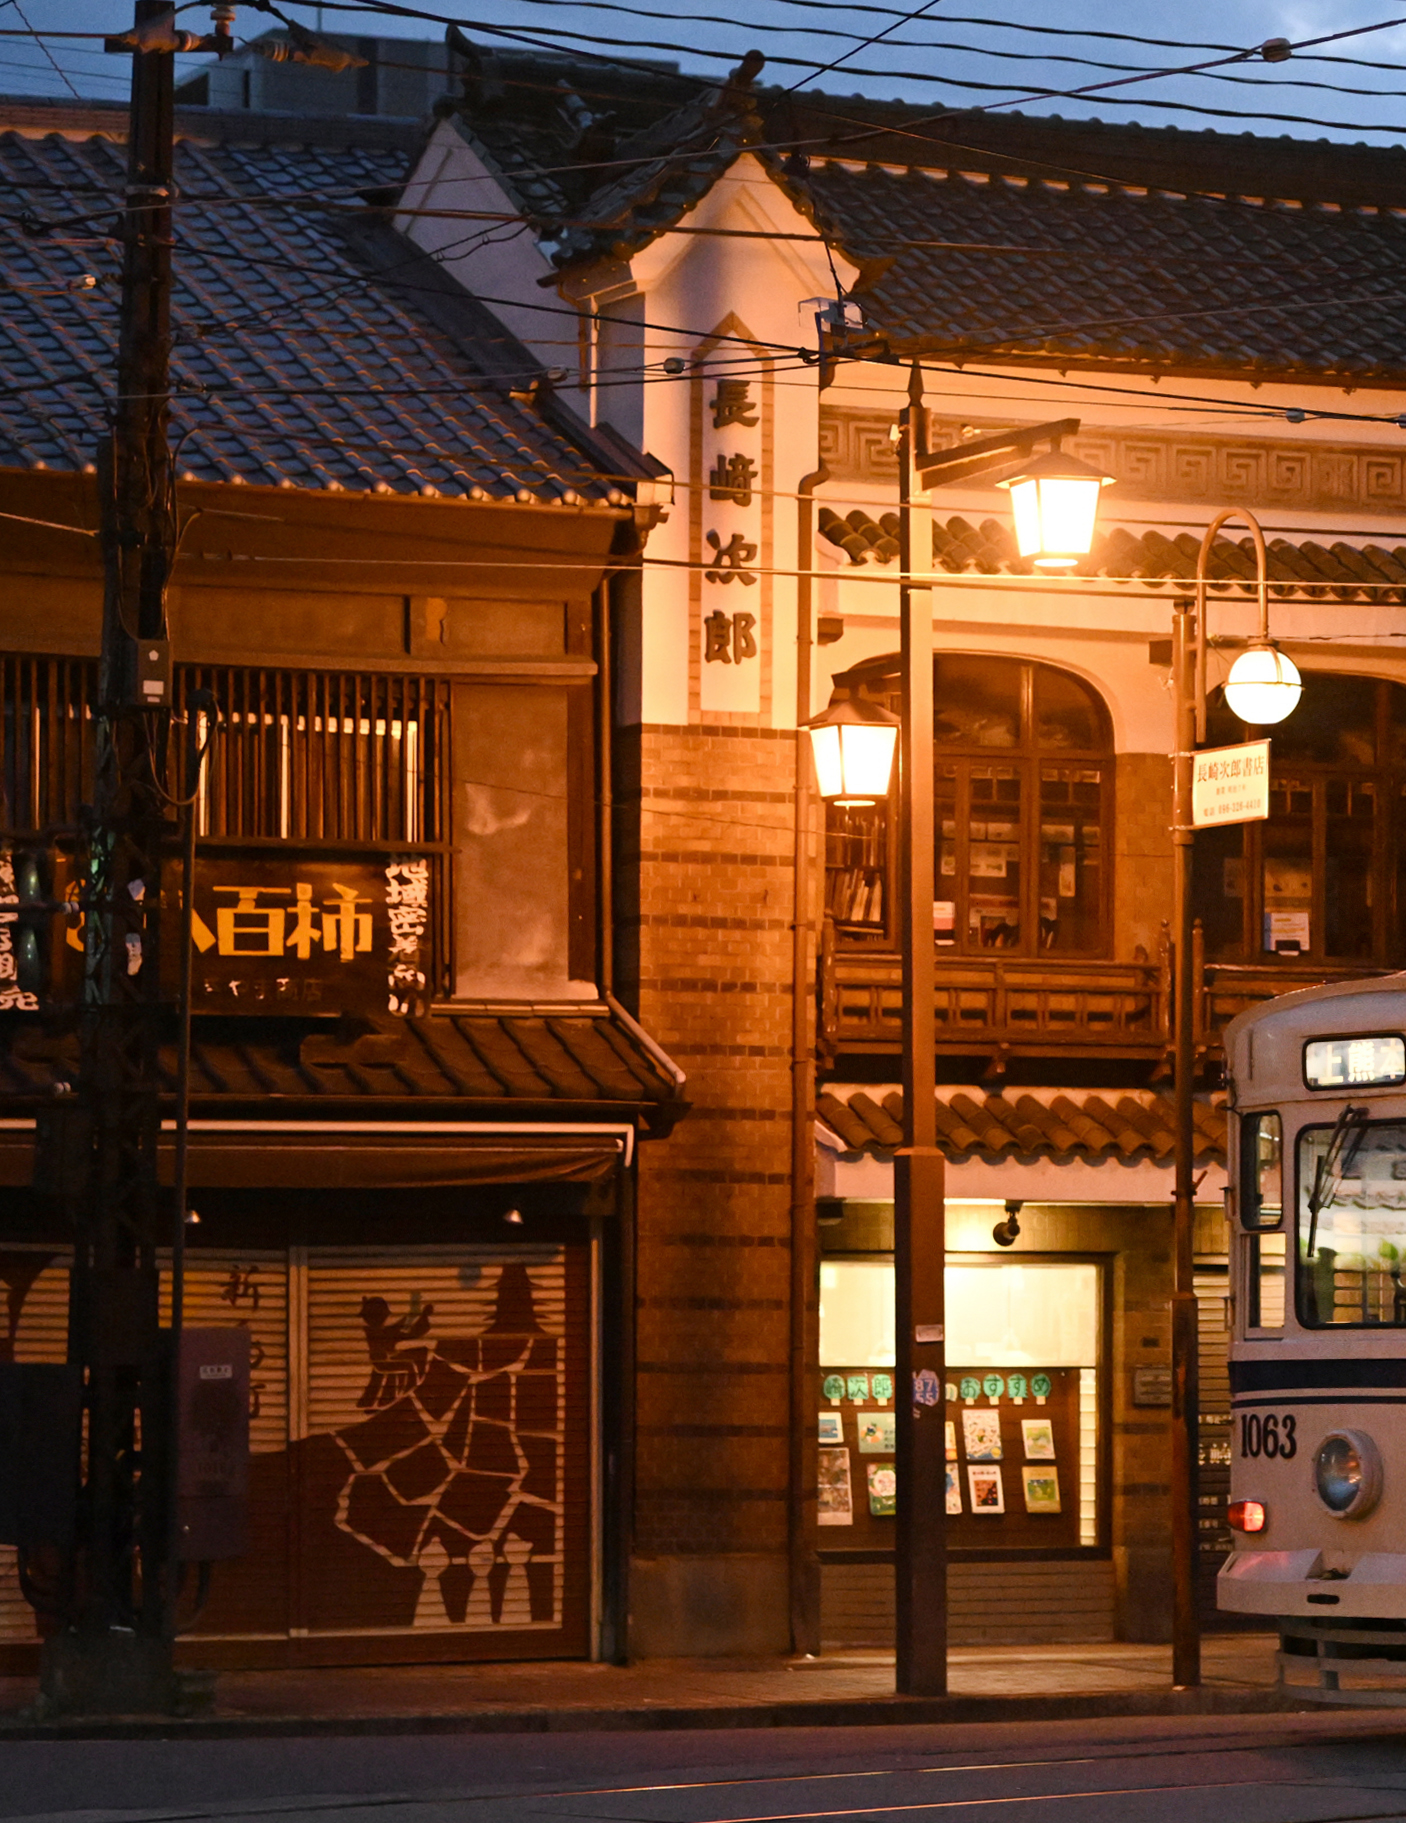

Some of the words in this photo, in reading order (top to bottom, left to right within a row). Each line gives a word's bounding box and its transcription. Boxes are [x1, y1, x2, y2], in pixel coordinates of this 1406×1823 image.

[1318, 1038, 1405, 1084] 上熊本
[1241, 1414, 1296, 1458] 1063
